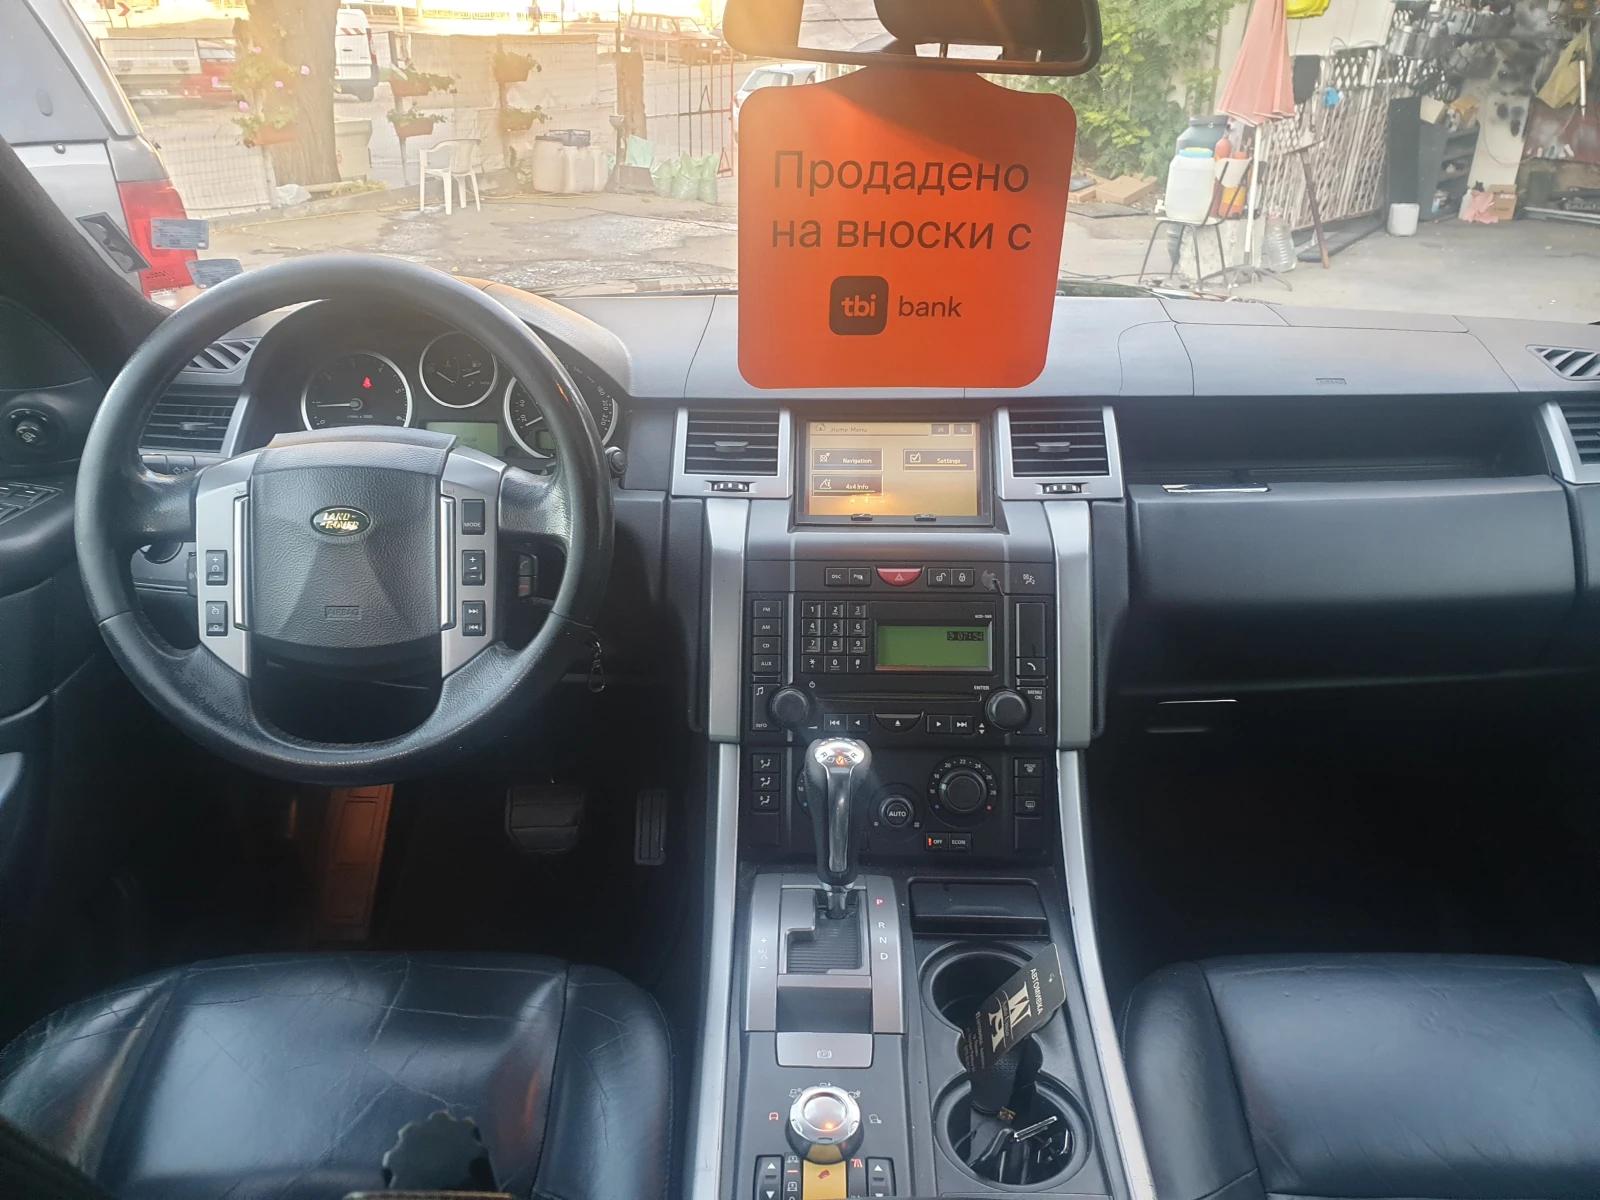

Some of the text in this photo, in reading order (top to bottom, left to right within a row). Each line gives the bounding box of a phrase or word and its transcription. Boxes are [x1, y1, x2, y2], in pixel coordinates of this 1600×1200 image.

[773, 150, 1030, 197] Продадено
[772, 219, 1032, 251] на вноски с
[841, 294, 962, 318] tbi bank
[879, 936, 887, 944] N
[880, 952, 888, 960] D
[1030, 968, 1044, 1015] АВТОМИВКА
